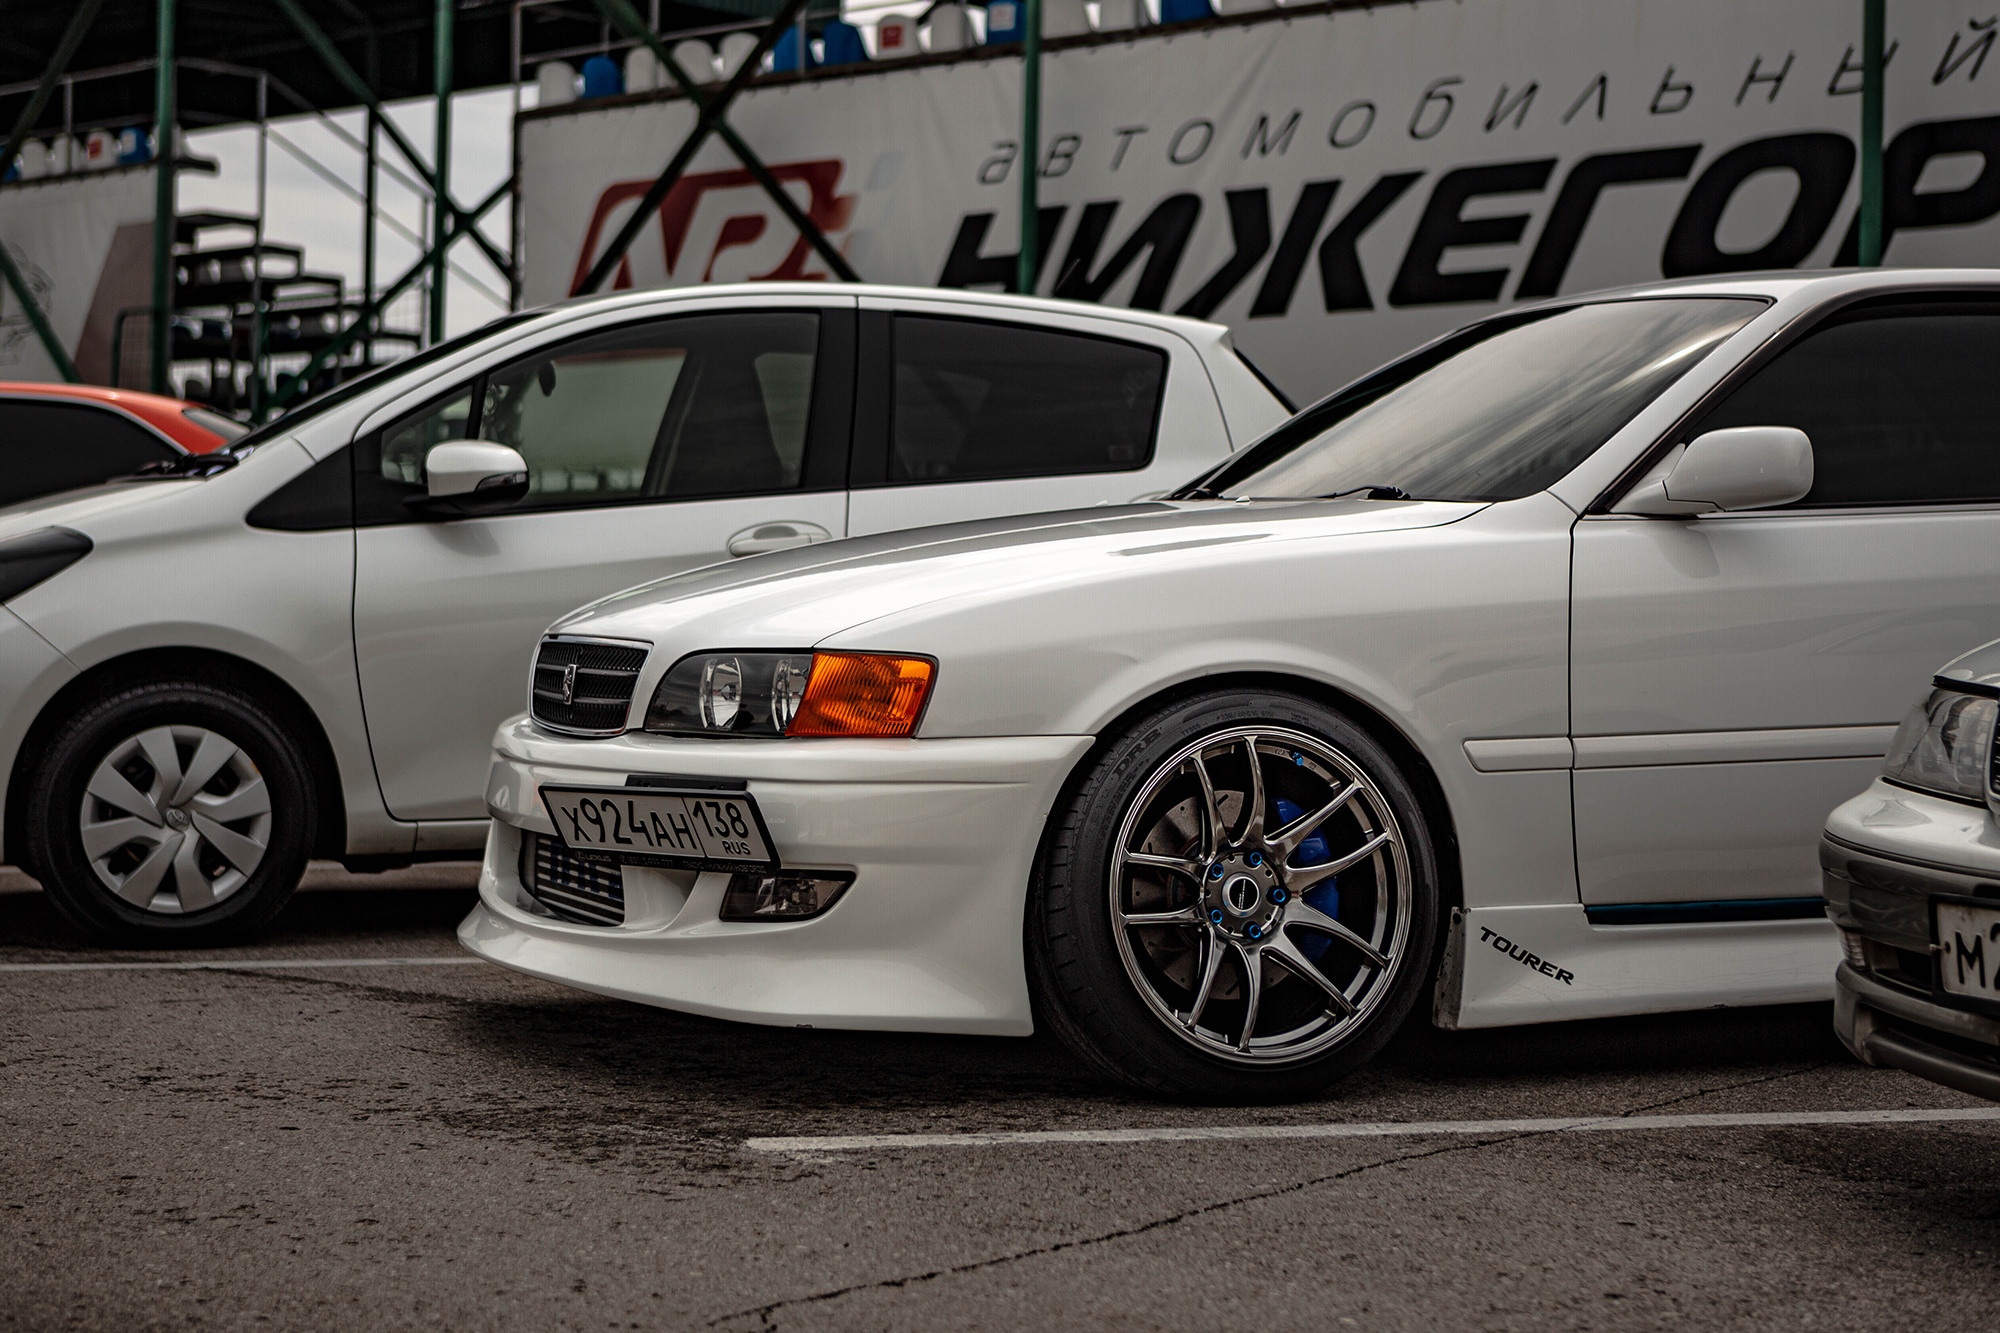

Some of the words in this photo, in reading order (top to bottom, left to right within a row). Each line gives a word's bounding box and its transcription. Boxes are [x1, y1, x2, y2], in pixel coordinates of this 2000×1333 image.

[692, 800, 749, 839] 138
[721, 839, 751, 855] RUS
[1480, 926, 1575, 986] TOURER
